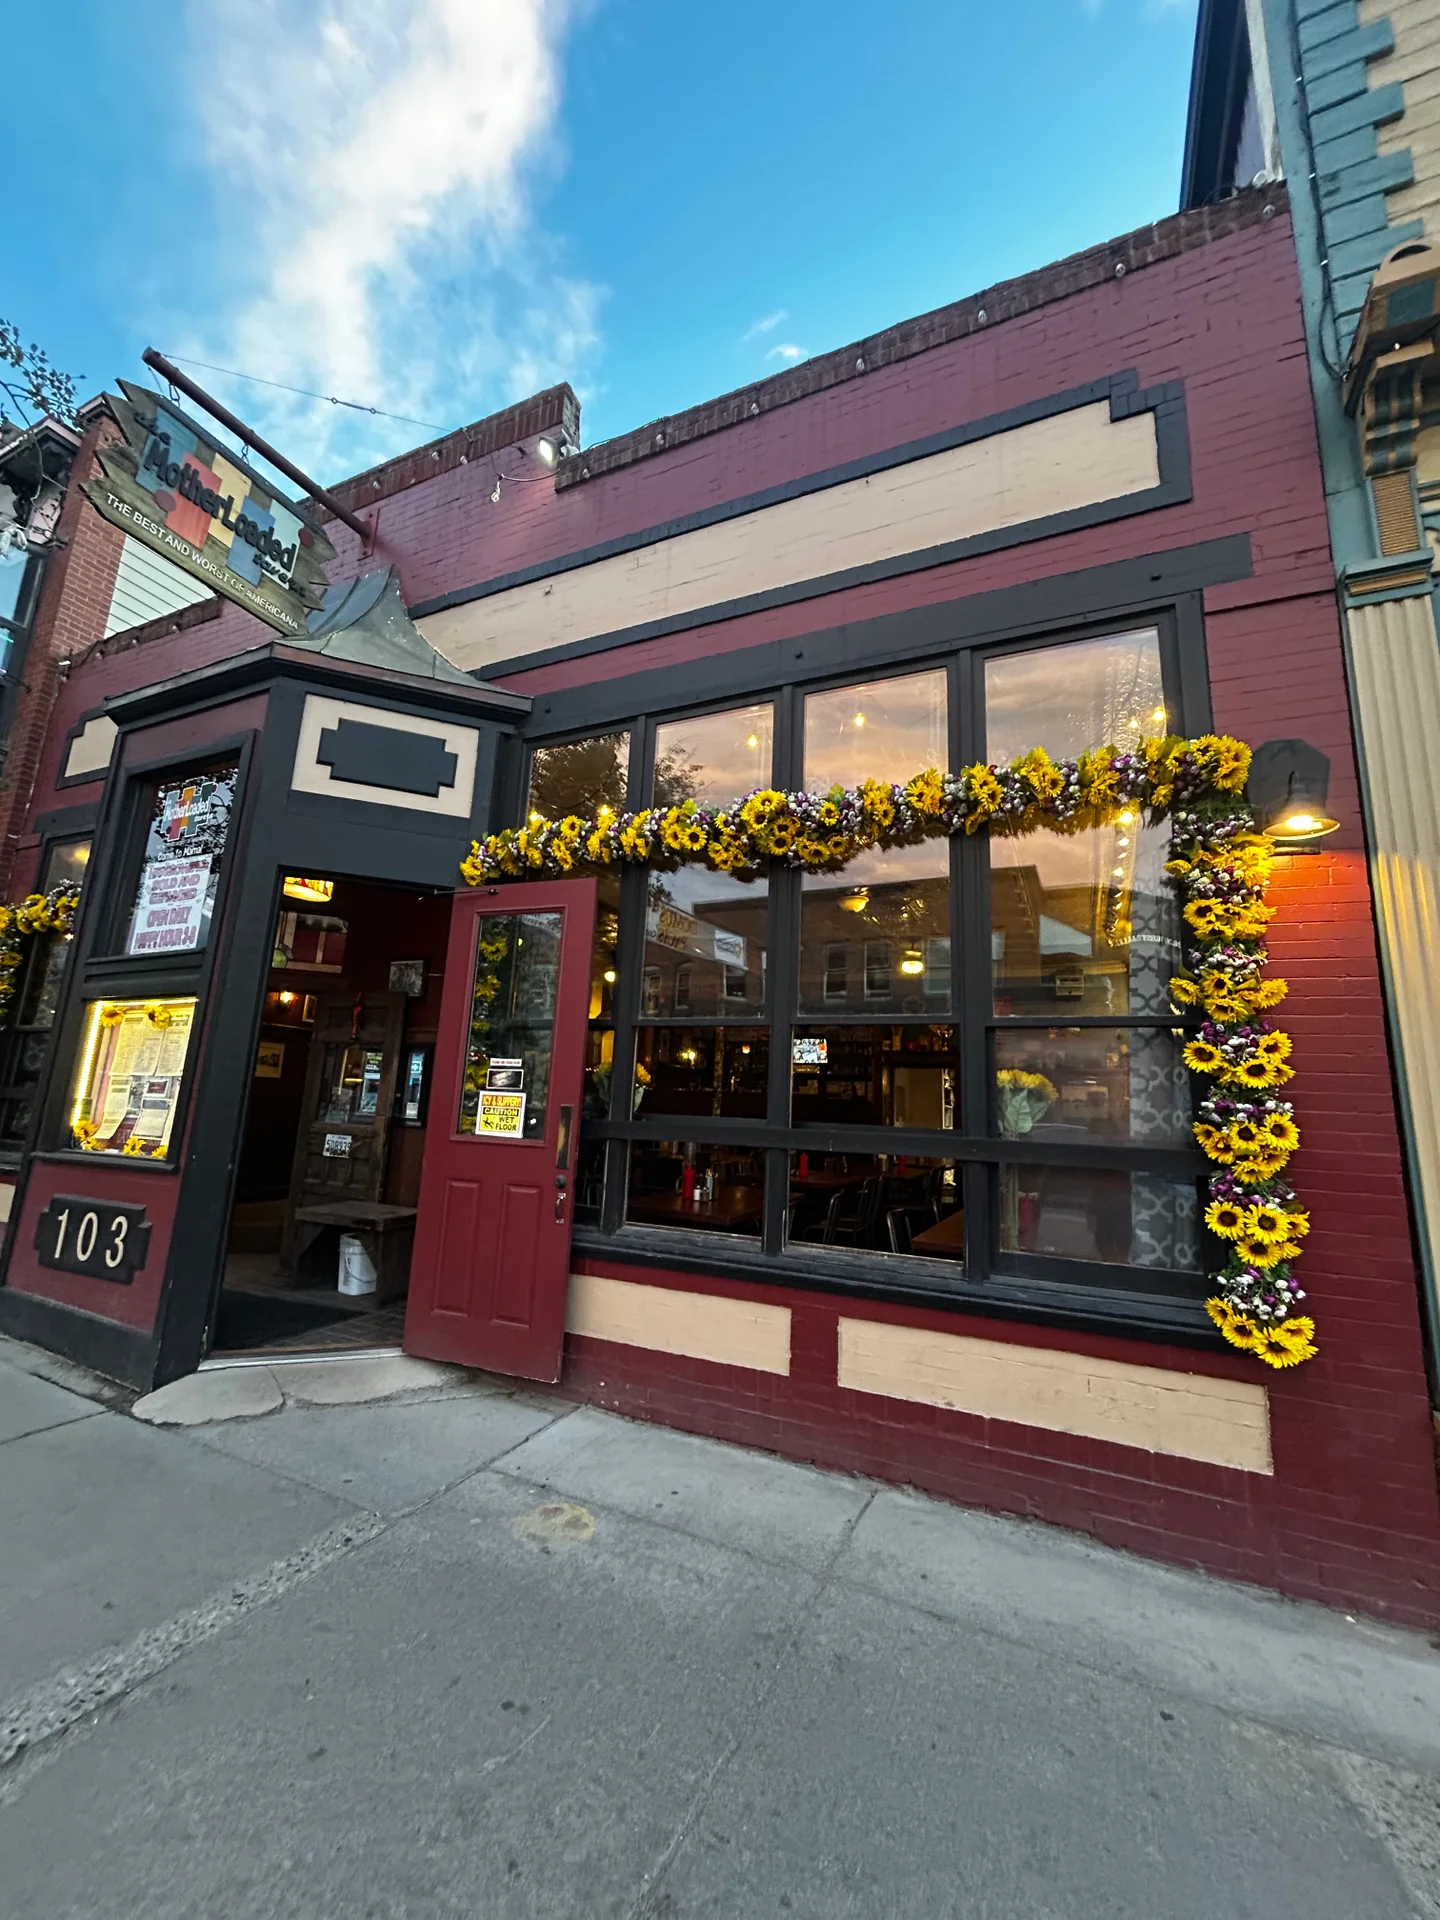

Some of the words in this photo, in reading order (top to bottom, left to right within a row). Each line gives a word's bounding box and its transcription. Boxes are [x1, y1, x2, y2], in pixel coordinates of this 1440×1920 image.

[106, 492, 132, 518] THE
[132, 510, 167, 540] BEST
[164, 534, 190, 557] AND
[190, 550, 236, 584] WORST
[230, 577, 247, 592] OF
[244, 588, 299, 631] AMERICANA
[175, 849, 183, 858] to
[134, 929, 161, 950] HAPPY
[158, 927, 183, 948] HOUR
[482, 1095, 493, 1106] ICY
[484, 1107, 518, 1116] CAUTION
[498, 1116, 515, 1124] WET
[495, 1123, 517, 1132] FLOOR
[54, 1208, 128, 1268] 103
